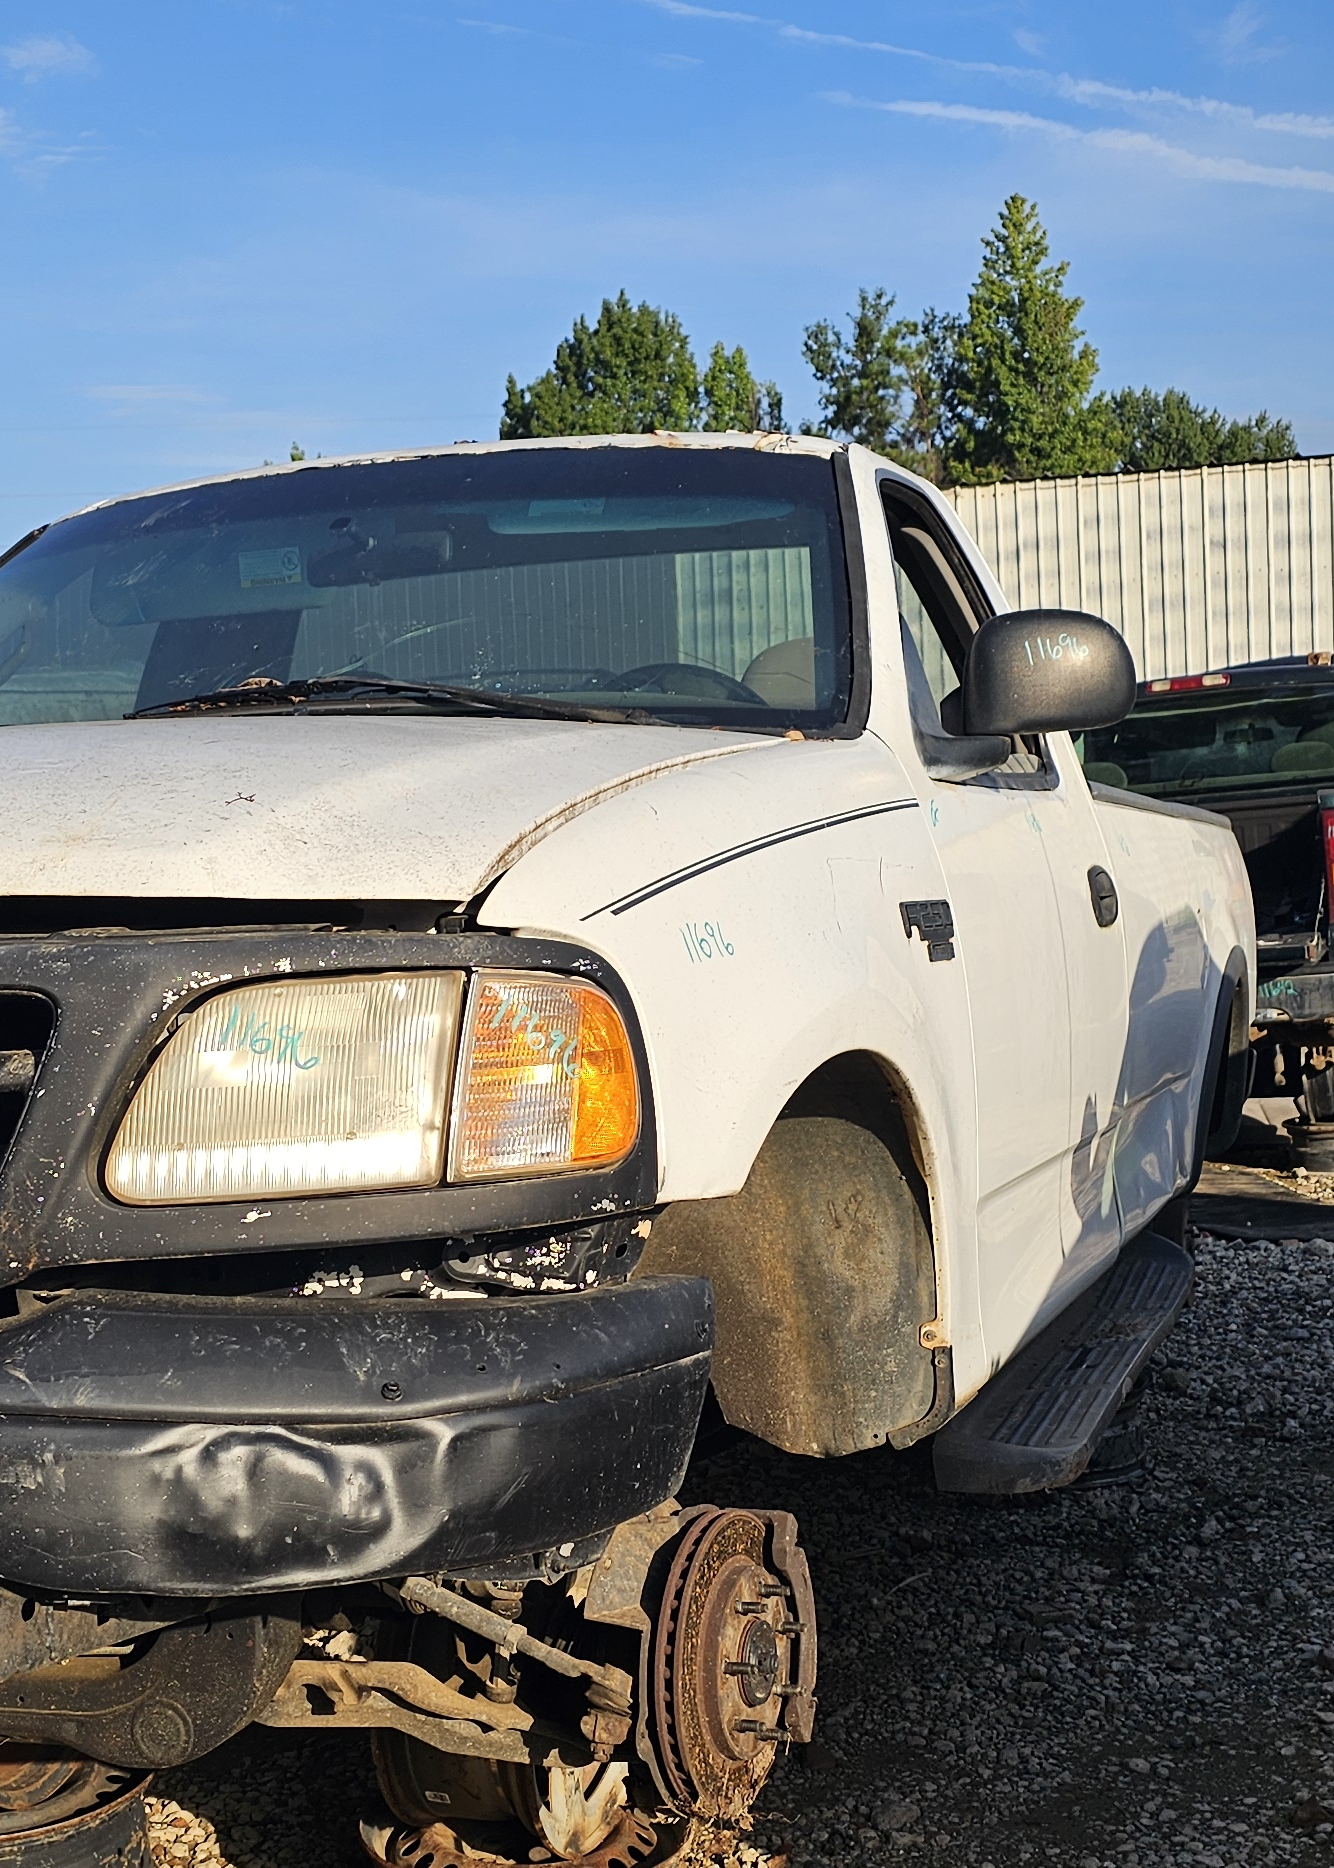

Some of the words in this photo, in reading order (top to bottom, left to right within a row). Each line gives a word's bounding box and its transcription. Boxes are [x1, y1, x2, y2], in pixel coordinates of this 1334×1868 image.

[1024, 633, 1089, 666] 11696
[678, 921, 735, 964] 11696
[220, 1004, 320, 1070] 11696
[489, 992, 581, 1079] 11696
